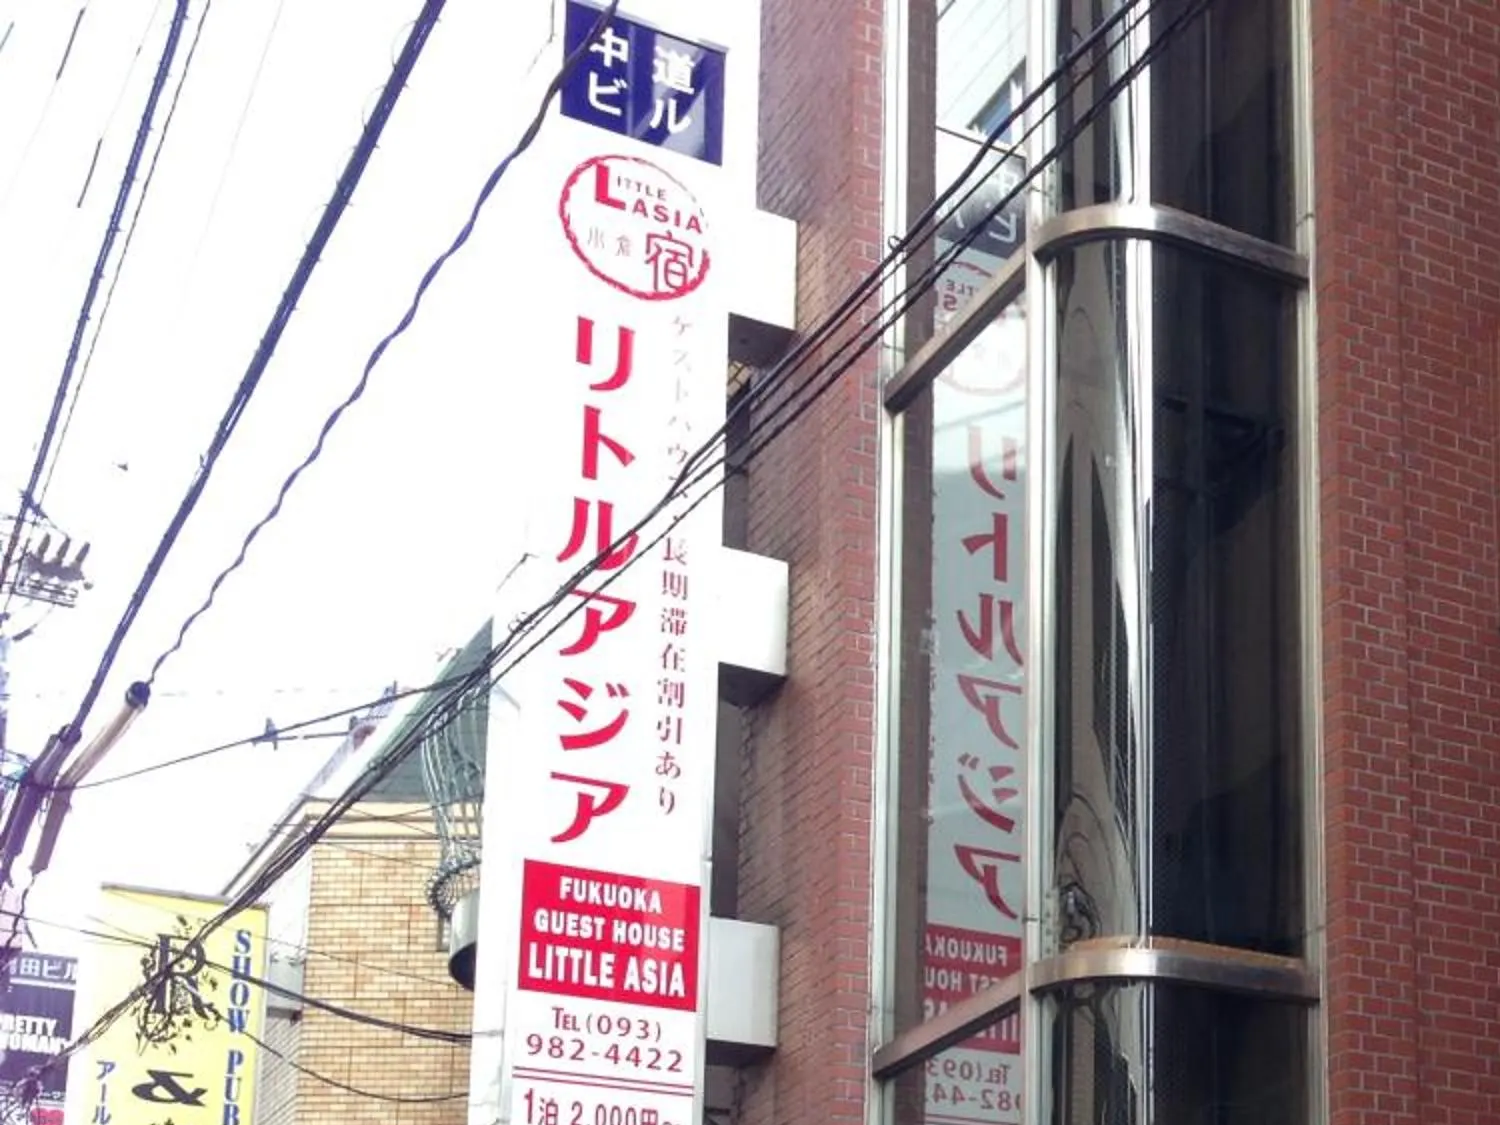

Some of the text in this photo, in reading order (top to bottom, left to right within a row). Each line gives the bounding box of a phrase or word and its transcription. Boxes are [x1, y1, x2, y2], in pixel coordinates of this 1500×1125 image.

[632, 198, 702, 234] ASIA
[549, 314, 640, 844] リトルアジア
[559, 876, 663, 914] FUKUOKA
[534, 908, 685, 951] GUEST HOUSE
[228, 929, 252, 1033] SHOW
[528, 942, 685, 998] LITTLE ASIA
[526, 1033, 683, 1073] 982-4422
